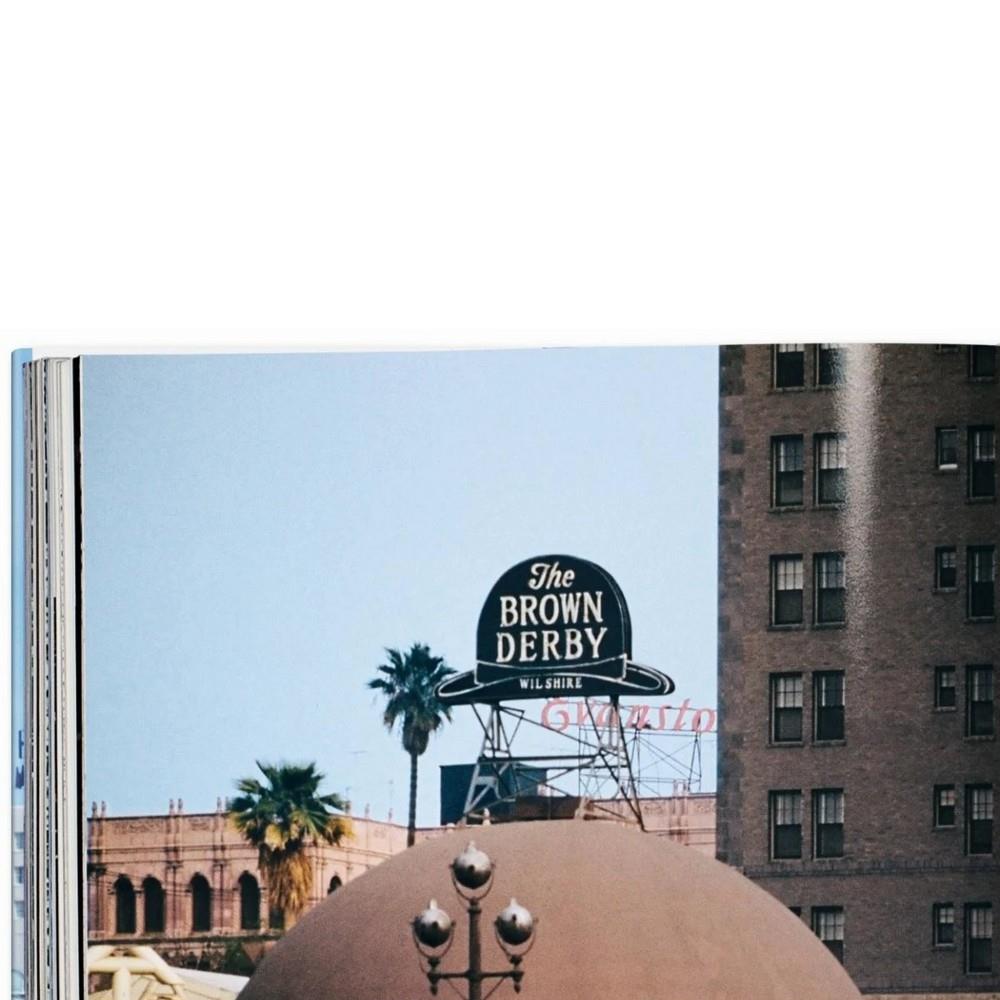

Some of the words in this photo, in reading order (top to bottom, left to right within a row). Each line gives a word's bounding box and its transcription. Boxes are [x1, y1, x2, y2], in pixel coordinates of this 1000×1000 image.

[528, 561, 575, 589] The
[500, 591, 603, 627] BROWN
[496, 627, 608, 663] DERBY
[519, 676, 583, 690] WILSHIRE
